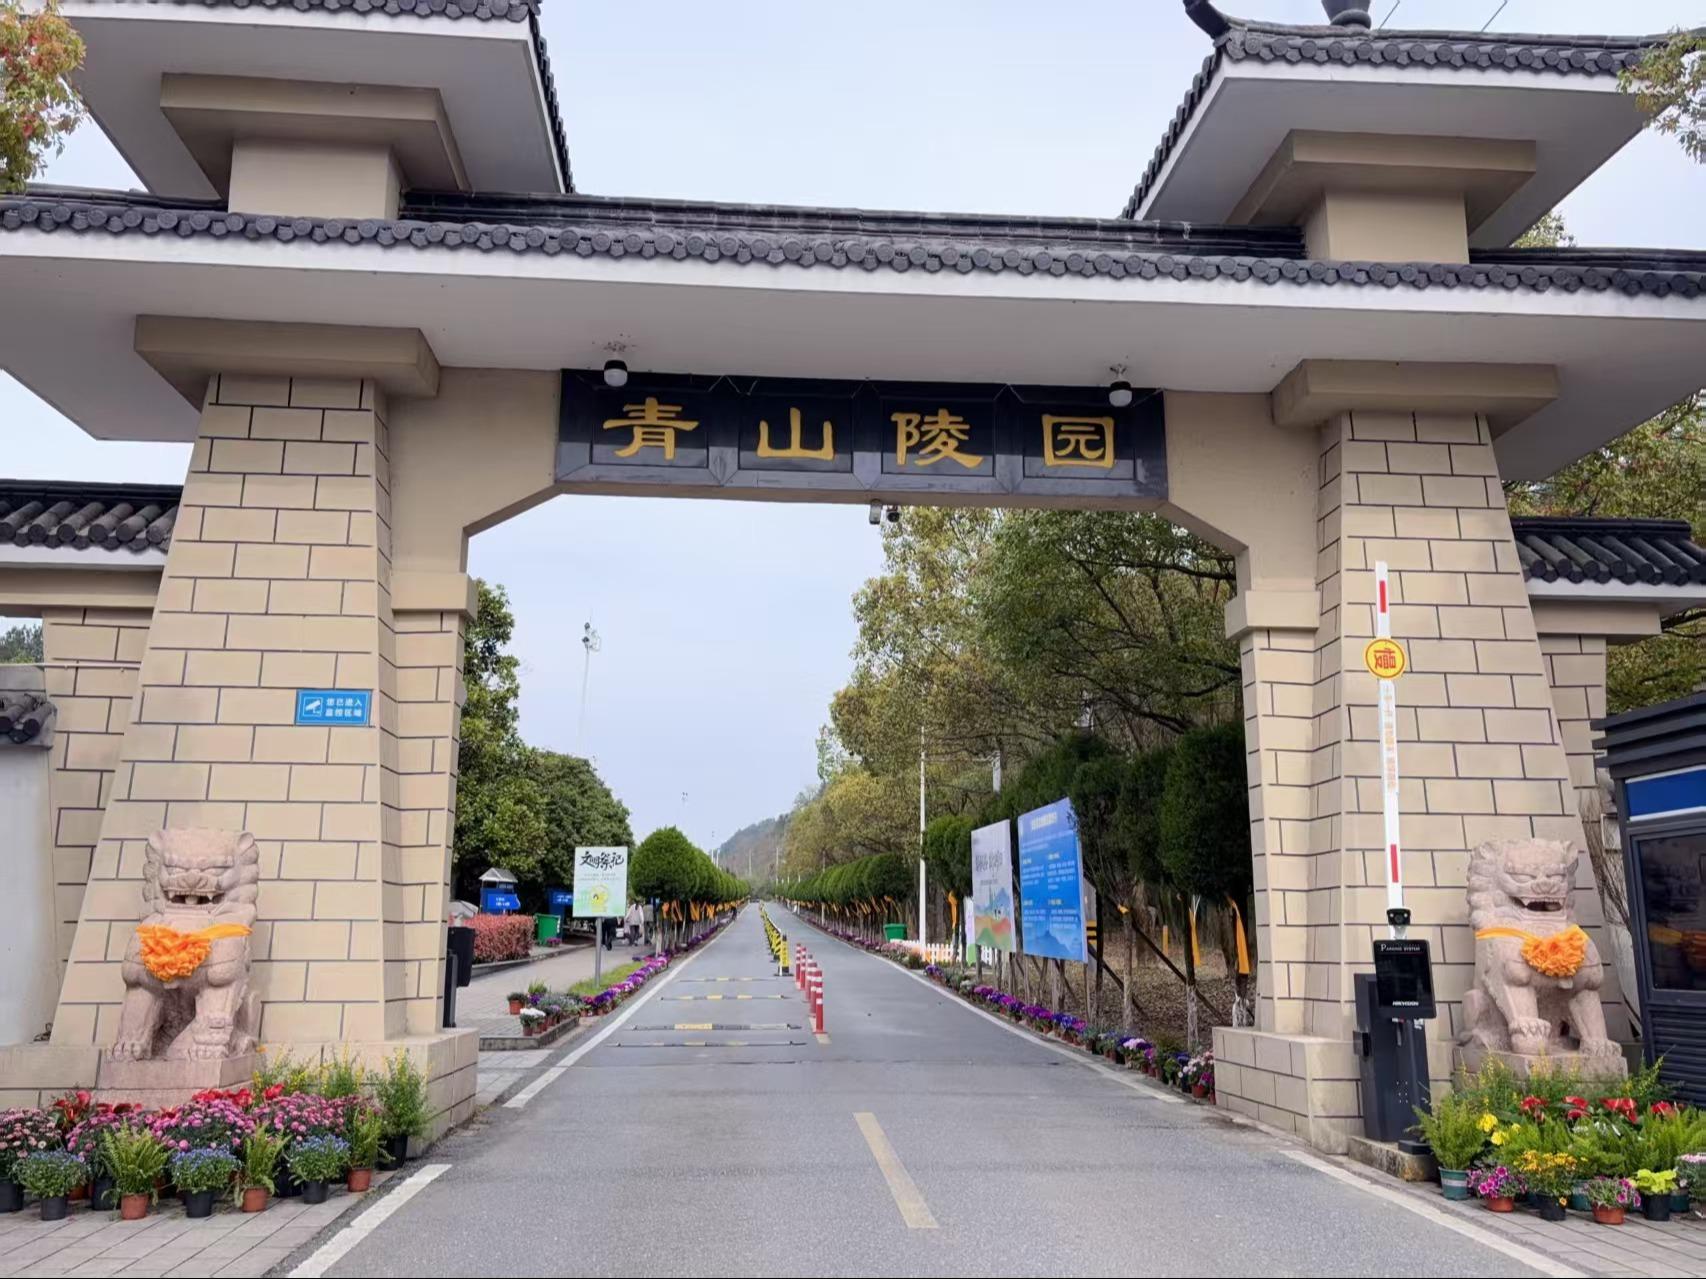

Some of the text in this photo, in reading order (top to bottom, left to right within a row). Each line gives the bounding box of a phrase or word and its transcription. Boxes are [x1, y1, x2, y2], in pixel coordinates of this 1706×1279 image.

[603, 397, 1115, 469] 青山陵园
[1373, 648, 1396, 669] 慢
[580, 850, 625, 871] 文明祭祀
